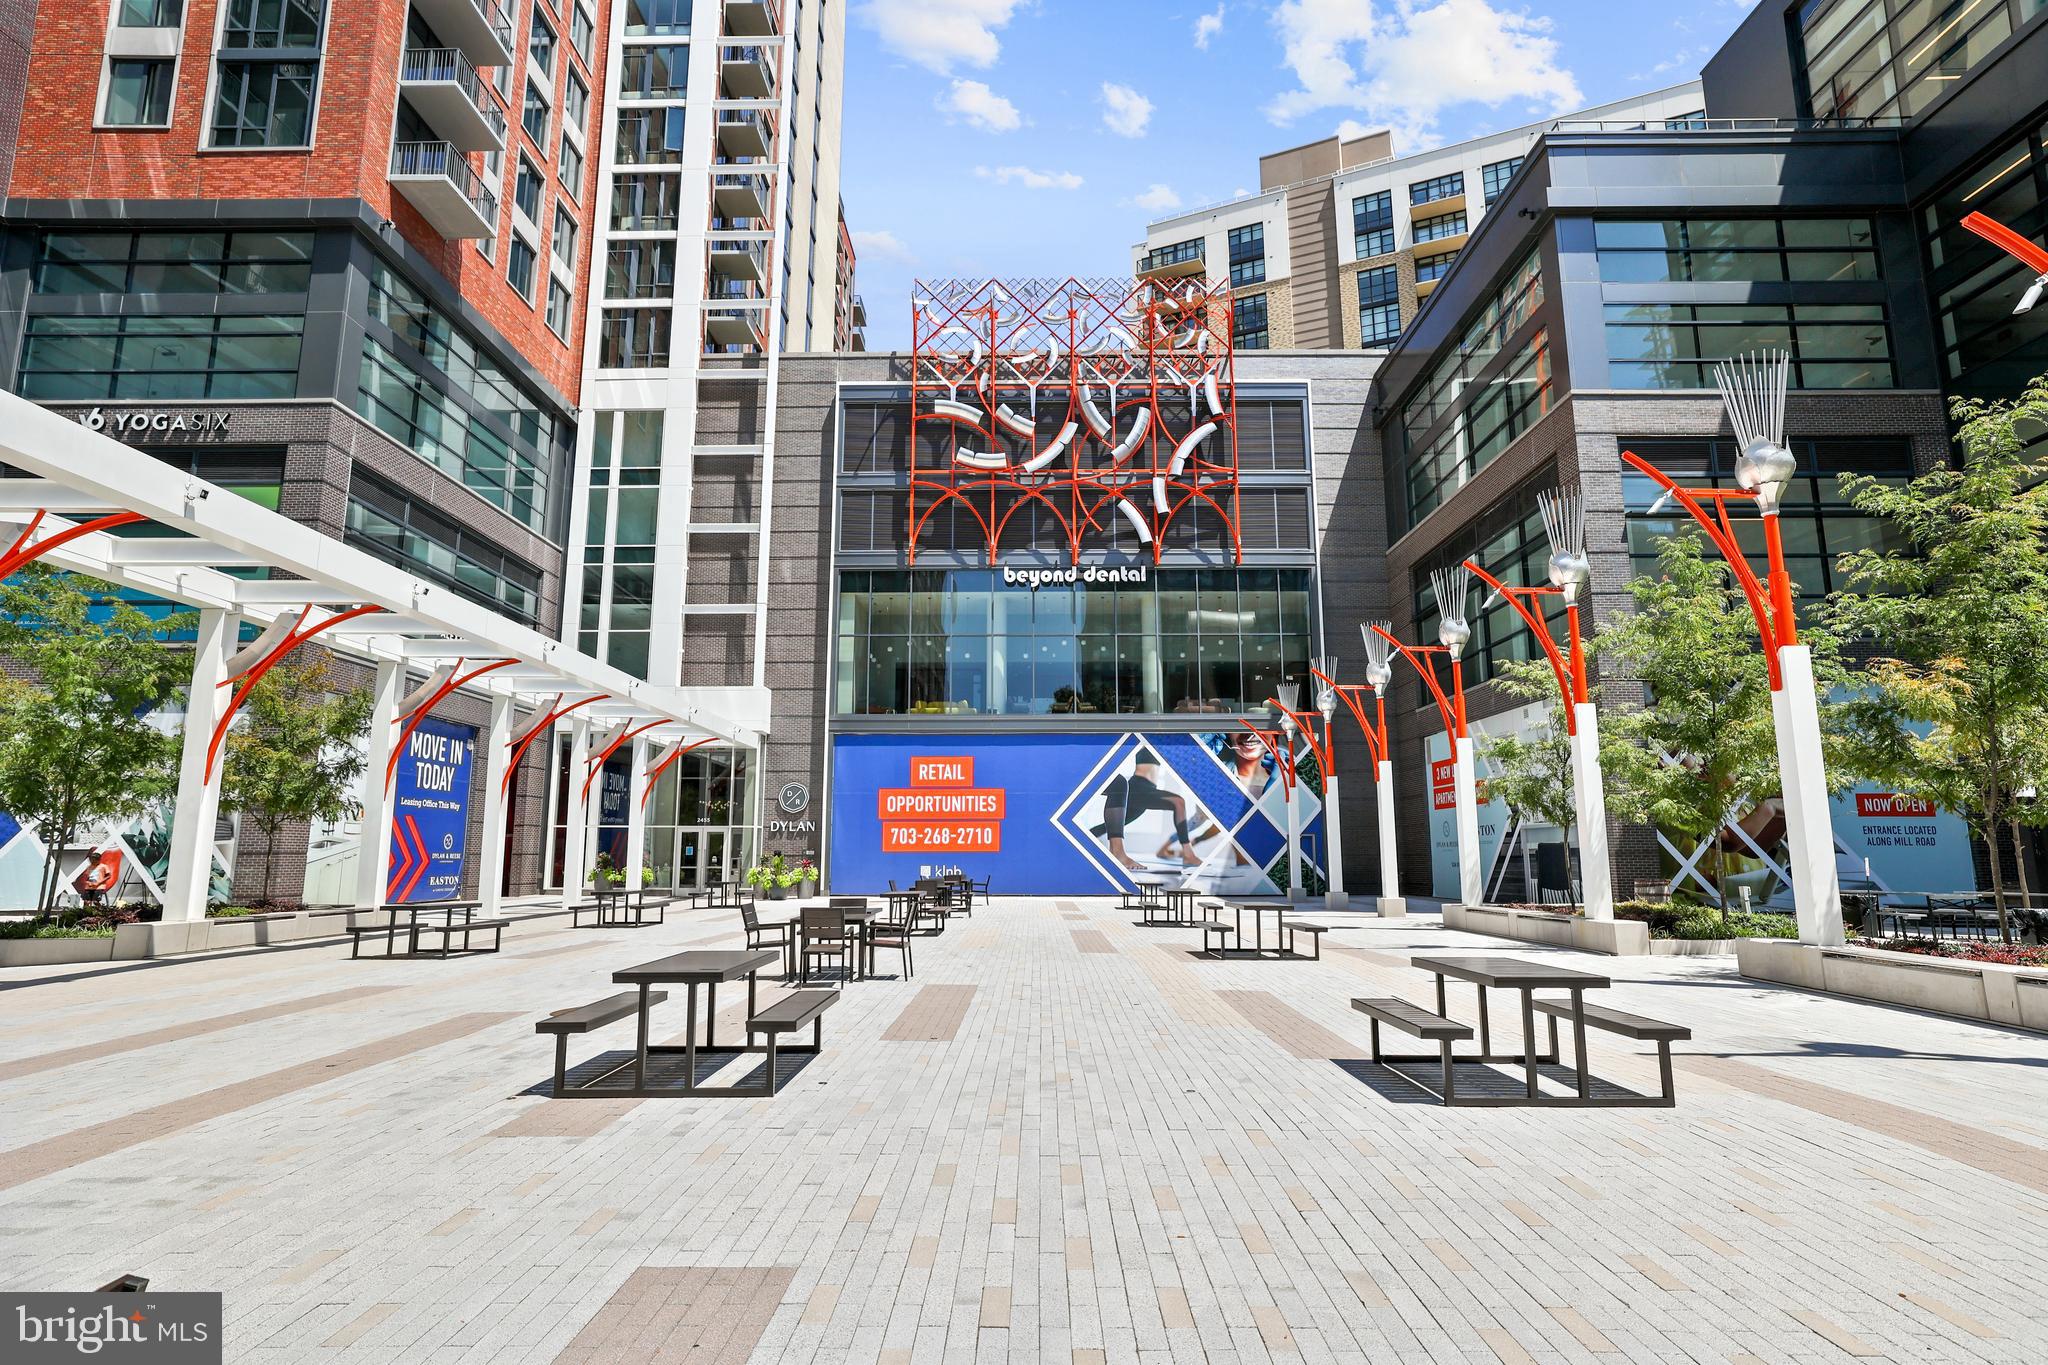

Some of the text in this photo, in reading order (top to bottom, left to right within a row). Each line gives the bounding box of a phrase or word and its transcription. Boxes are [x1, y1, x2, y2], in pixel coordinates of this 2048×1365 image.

[1003, 565, 1146, 588] beyond dental
[410, 731, 464, 765] MOVE IN
[416, 762, 455, 792] TODAY
[919, 763, 965, 780] RETAIL
[400, 797, 422, 809] Leasing
[422, 799, 438, 808] Office
[438, 800, 449, 809] This
[886, 795, 997, 812] OPPORTUNITIES
[1864, 798, 1927, 812] NOW OPEN
[770, 821, 815, 832] DYLAN
[1862, 825, 1937, 835] ENTRANCE LOCATED
[890, 827, 993, 844] 703-268-2710
[1867, 836, 1936, 846] ALONG MILL ROAD
[429, 875, 460, 886] EASTON
